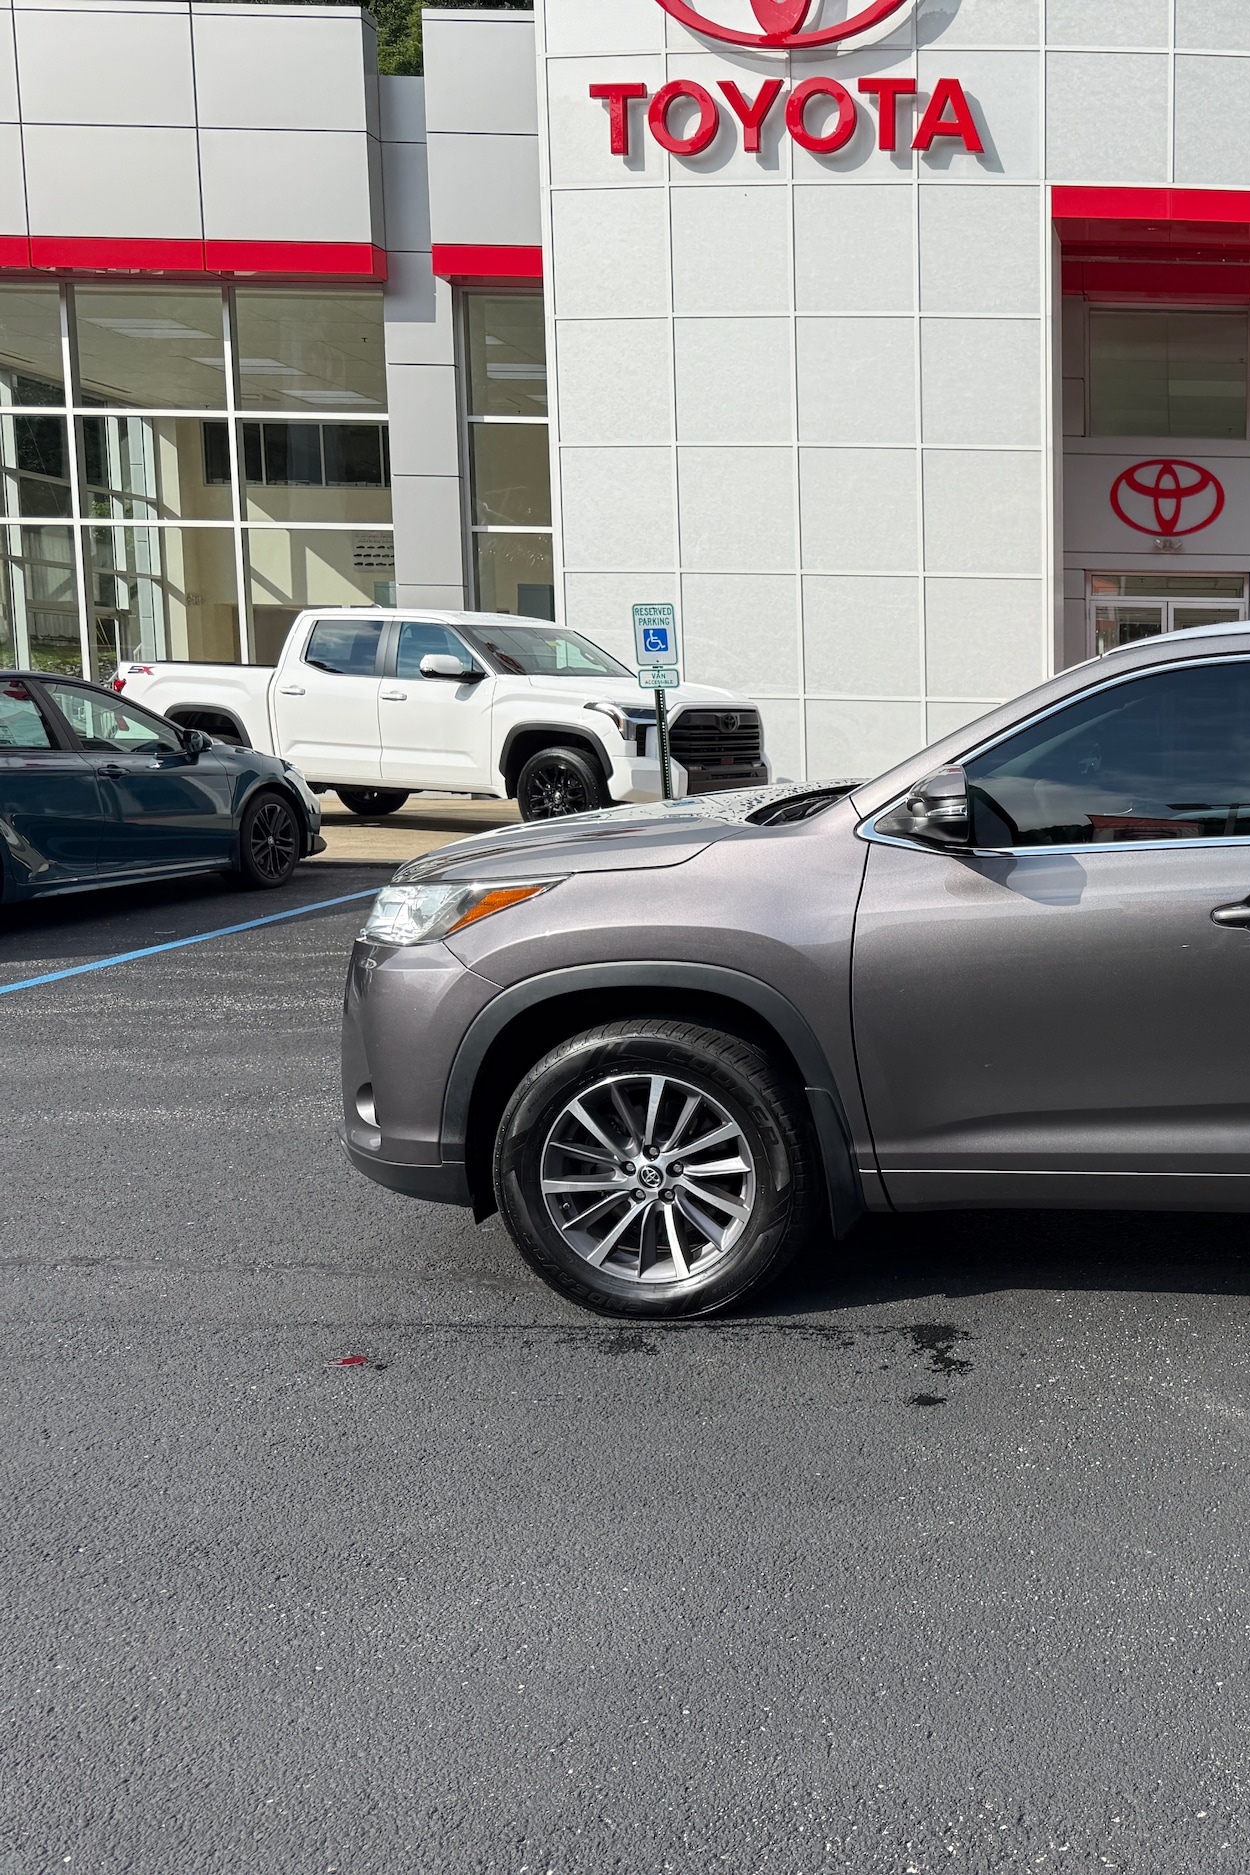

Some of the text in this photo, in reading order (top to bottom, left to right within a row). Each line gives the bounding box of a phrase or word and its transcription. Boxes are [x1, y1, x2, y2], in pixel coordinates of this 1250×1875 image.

[589, 76, 985, 157] TOYOTA
[635, 607, 672, 616] RESERVED
[638, 618, 670, 626] PARKING
[667, 1048, 780, 1147] COOPER
